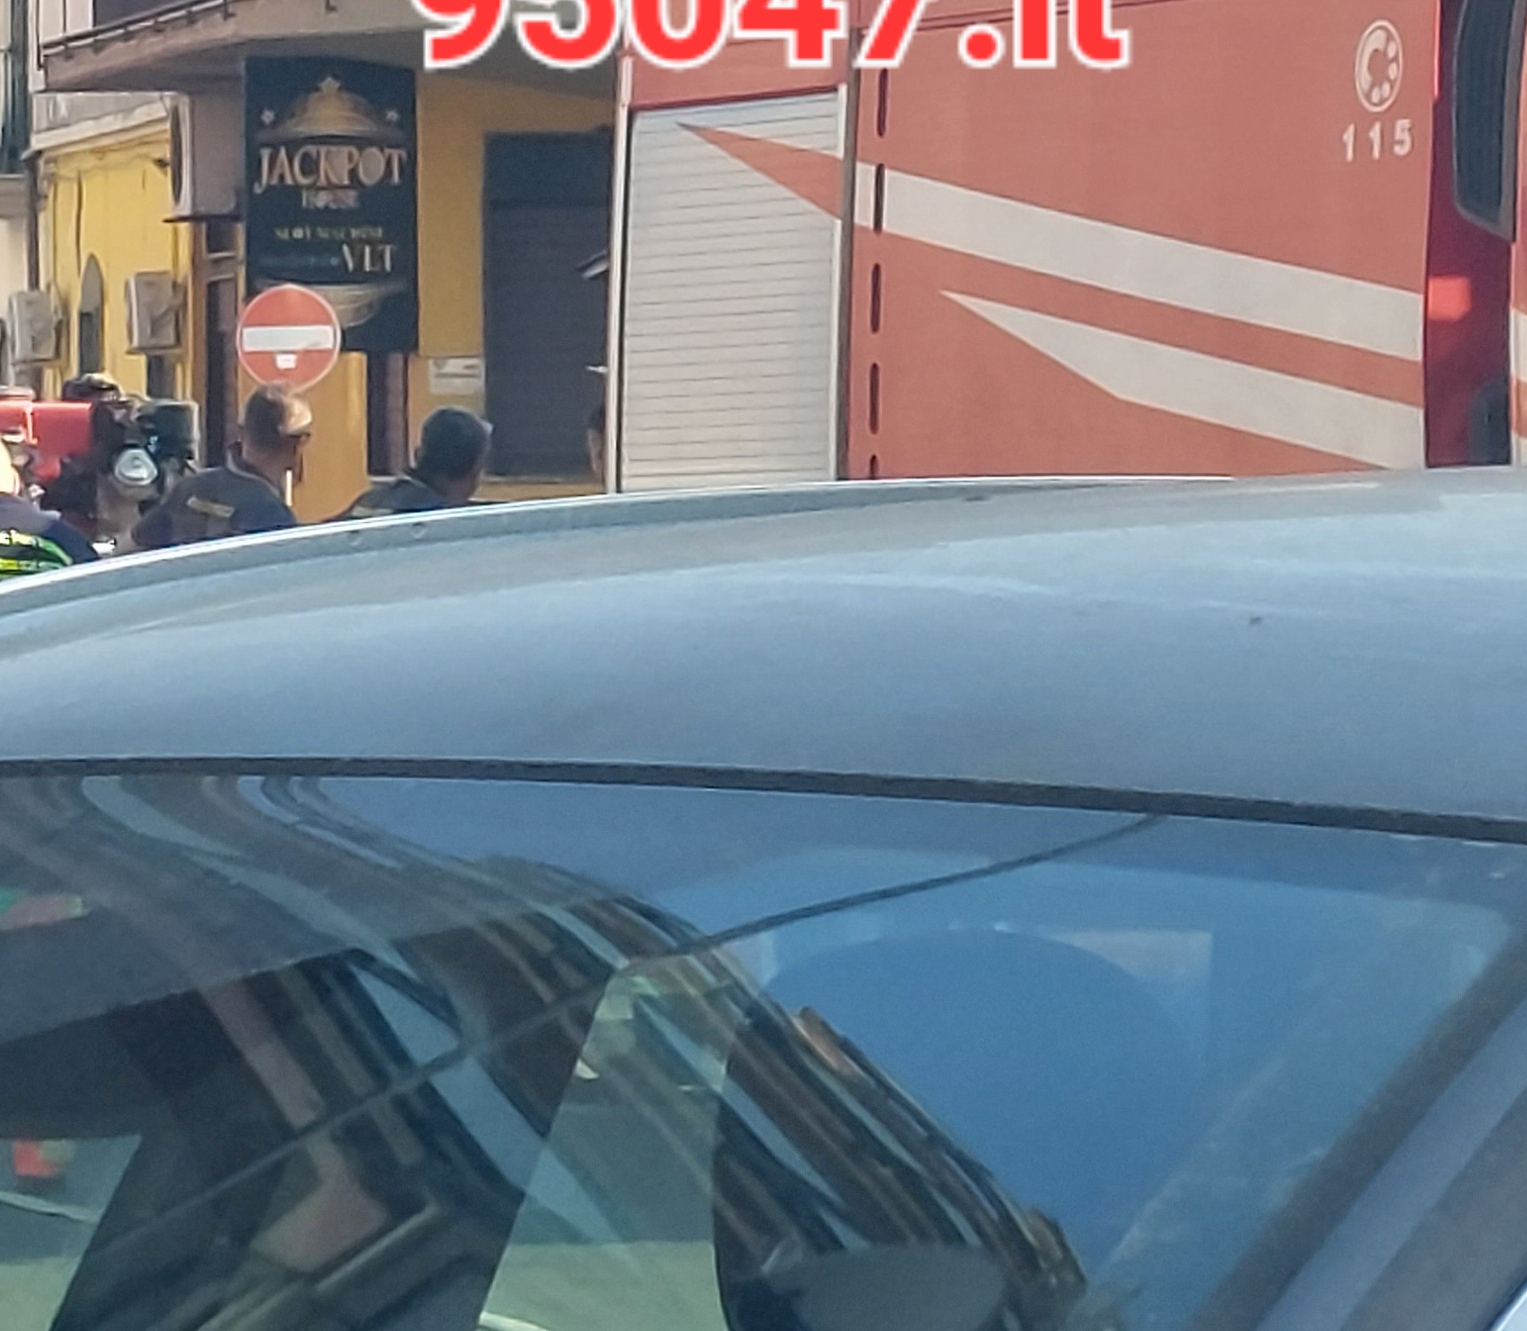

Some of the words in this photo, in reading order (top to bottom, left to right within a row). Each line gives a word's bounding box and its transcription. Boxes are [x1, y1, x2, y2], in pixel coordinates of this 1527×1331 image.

[1341, 117, 1413, 163] 115
[253, 143, 407, 194] JACKPOT
[341, 242, 398, 273] VLT
